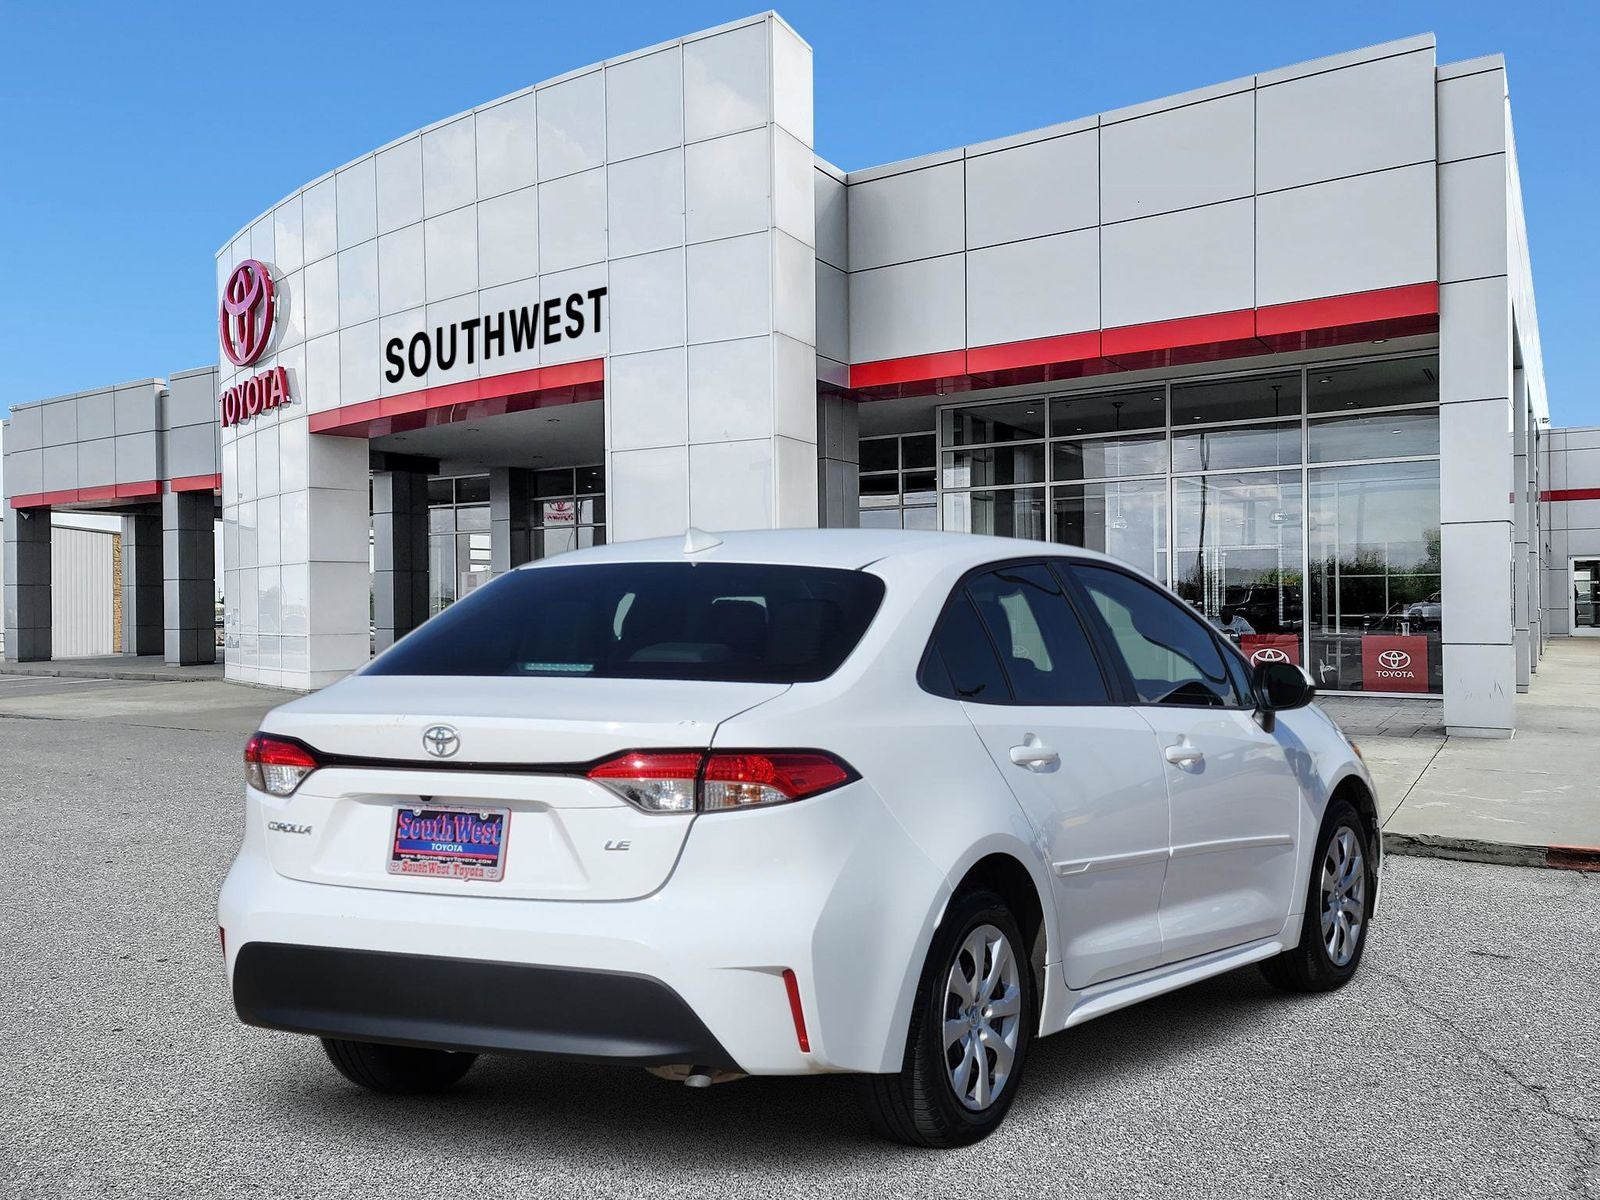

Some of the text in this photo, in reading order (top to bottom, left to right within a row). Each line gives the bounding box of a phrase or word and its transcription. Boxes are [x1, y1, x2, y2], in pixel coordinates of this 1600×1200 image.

[385, 286, 608, 384] SOUTHWEST
[219, 366, 291, 428] TOYOTA
[1375, 670, 1415, 678] TOYOTA
[267, 820, 313, 836] COROLLA
[431, 843, 463, 853] TOYOTA
[604, 840, 632, 851] LE
[453, 864, 484, 879] Toyota
